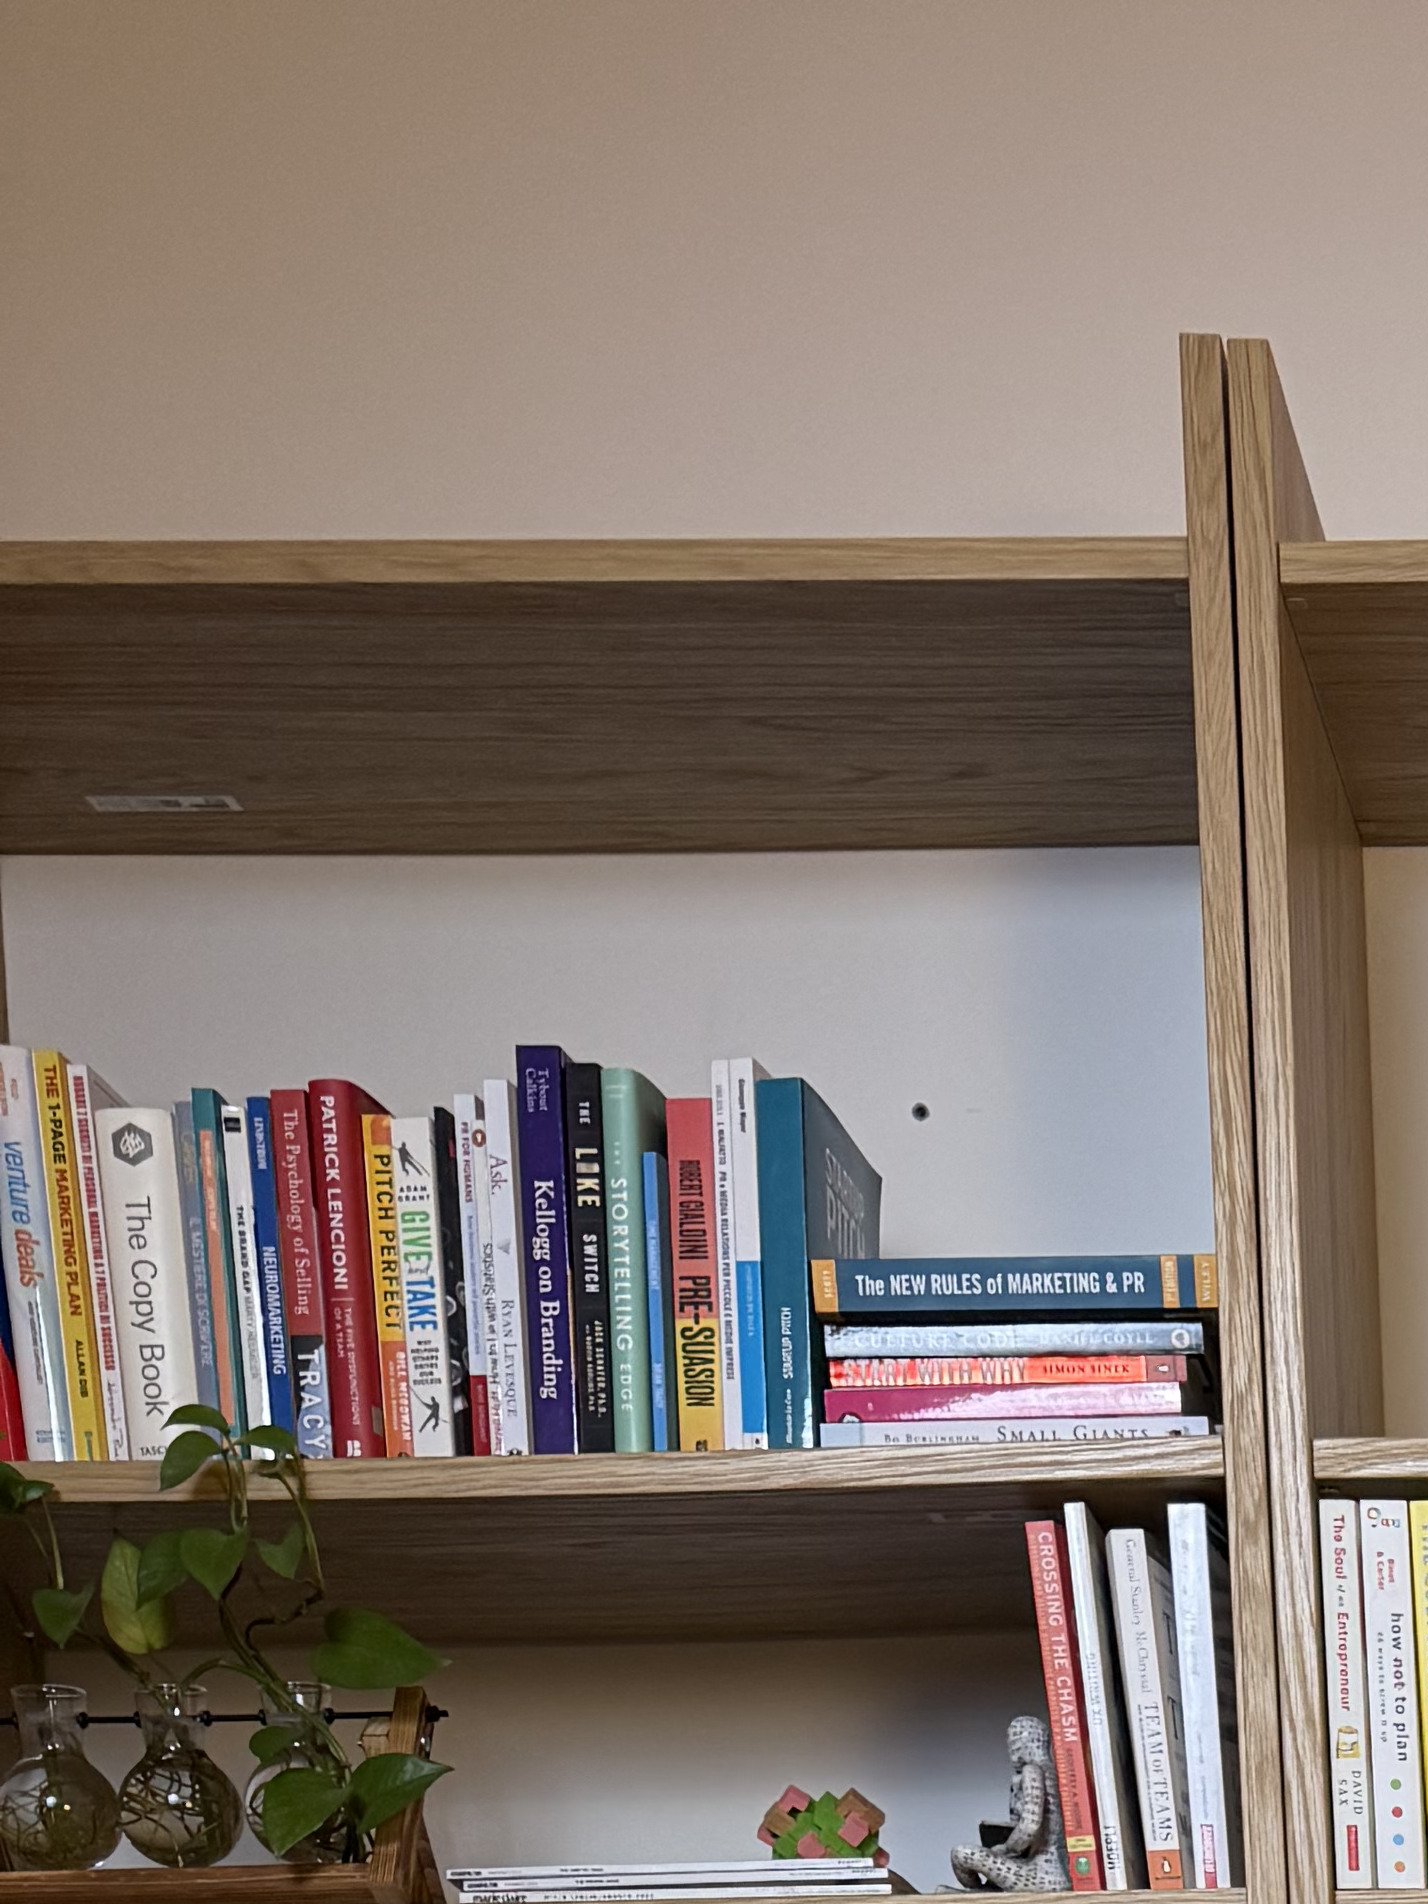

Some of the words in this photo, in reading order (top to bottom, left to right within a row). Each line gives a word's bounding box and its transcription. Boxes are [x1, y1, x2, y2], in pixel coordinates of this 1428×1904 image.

[43, 1064, 60, 1099] THE
[525, 1067, 536, 1113] Calkins
[538, 1067, 550, 1111] Tybout
[48, 1103, 67, 1165] 1-PAGE
[283, 1109, 298, 1140] The
[579, 1101, 591, 1124] THE
[320, 1095, 340, 1182] PATRICK
[462, 1136, 471, 1157] FOR
[4, 1141, 32, 1225] venture
[282, 1145, 305, 1232] Psychology
[373, 1154, 394, 1220] PITCH
[399, 1185, 428, 1193] ADAM
[463, 1160, 473, 1203] HUMANS
[488, 1154, 508, 1196] Ask.
[575, 1147, 600, 1207] LIKE
[54, 1168, 77, 1267] MARKETING
[236, 1205, 246, 1227] THE
[398, 1194, 431, 1203] GRANT
[532, 1180, 556, 1261] Kellogg
[720, 1190, 728, 1217] MEDIA
[125, 1195, 152, 1250] The
[327, 1188, 349, 1290] LENCIONI
[401, 1210, 432, 1262] GIVE
[678, 1200, 709, 1260] CIALDINI
[721, 1218, 731, 1260] RELATIONS
[14, 1228, 44, 1289] deals
[238, 1230, 250, 1268] BRAND
[294, 1239, 311, 1253] of
[481, 1242, 494, 1295] Statistics
[583, 1233, 600, 1293] SWITCH
[611, 1178, 634, 1351] STORYTELLING
[88, 1211, 103, 1261] MARKETING
[101, 1326, 115, 1371] SUCCESSO
[242, 1271, 252, 1294] GAP
[293, 1254, 312, 1316] Selling
[379, 1231, 401, 1330] PERFECT
[538, 1266, 552, 1293] on
[722, 1263, 731, 1277] PER
[854, 1274, 885, 1297] The
[890, 1274, 926, 1296] NEW
[931, 1273, 982, 1295] RULES
[987, 1273, 1002, 1295] of
[1007, 1272, 1100, 1295] MARKETING
[1105, 1271, 1118, 1293] &
[1122, 1271, 1145, 1294] PR
[1200, 1261, 1211, 1302] WILEY
[66, 1270, 83, 1317] PLAN
[129, 1260, 158, 1334] Copy
[262, 1246, 287, 1376] NEUROMARKETING
[405, 1275, 438, 1332] TAKE
[485, 1297, 496, 1323] with
[75, 1339, 86, 1377] ALLAN
[539, 1300, 564, 1399] Branding
[679, 1275, 716, 1407] PRE-SUASION
[139, 1344, 170, 1418] Book
[620, 1363, 634, 1411] EDGE
[844, 1358, 908, 1386] START
[918, 1357, 972, 1385] WITH
[981, 1357, 1025, 1385] WHY
[298, 1349, 327, 1450] TRACY
[996, 1425, 1061, 1443] SMALL
[1073, 1424, 1149, 1441] GIANTS
[1332, 1514, 1346, 1542] The
[1036, 1531, 1064, 1627] CROSSING
[1124, 1537, 1140, 1583] General
[1333, 1546, 1348, 1580] Soul
[1376, 1560, 1385, 1591] Carter
[1386, 1557, 1395, 1584] Binet
[1130, 1585, 1145, 1626] Stanley
[1050, 1632, 1069, 1669] THE
[1390, 1612, 1405, 1651] how
[1134, 1630, 1152, 1694] McChrystal
[1336, 1612, 1352, 1712] Entrepreneur
[1392, 1657, 1408, 1689] not
[1057, 1676, 1079, 1743] CHASM
[1144, 1701, 1163, 1755] TEAM
[1394, 1696, 1408, 1715] to
[1392, 1721, 1410, 1762] plan
[1150, 1758, 1165, 1775] OF
[1153, 1776, 1174, 1843] TEAMS
[1338, 1778, 1349, 1808] SAX
[1351, 1770, 1364, 1816] DAVID
